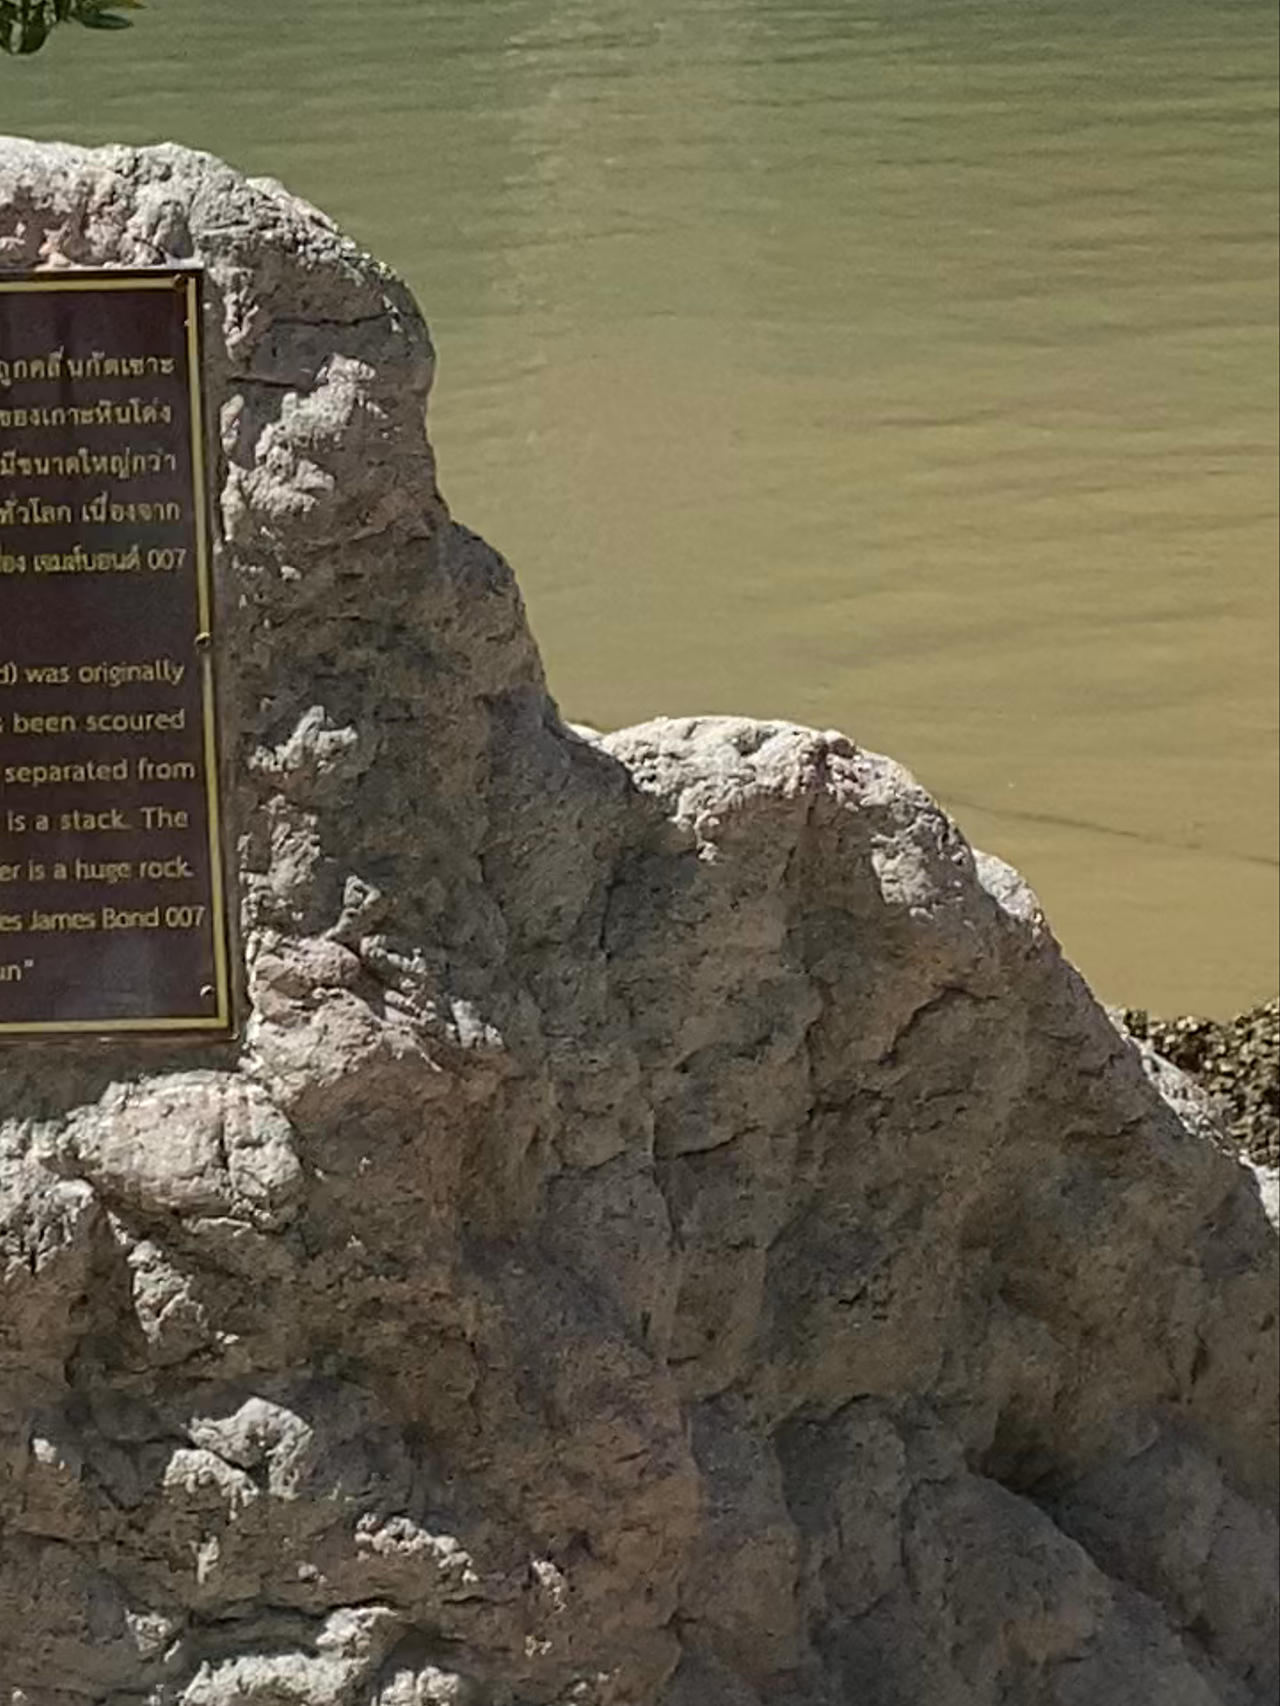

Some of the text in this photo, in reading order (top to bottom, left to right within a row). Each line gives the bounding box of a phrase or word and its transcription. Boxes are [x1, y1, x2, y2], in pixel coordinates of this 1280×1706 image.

[81, 490, 181, 524] เนื่องจาก
[147, 547, 187, 571] 007
[24, 666, 71, 684] was
[78, 658, 186, 687] originally
[13, 712, 76, 734] been
[86, 708, 186, 731] scoured
[5, 759, 129, 788] separated
[138, 756, 197, 781] from
[35, 814, 50, 832] a
[141, 805, 189, 829] The
[28, 859, 46, 882] is
[53, 863, 68, 881] a
[75, 857, 132, 884] huge
[29, 909, 96, 932] James
[102, 906, 160, 929] Bond
[165, 905, 207, 929] 007
